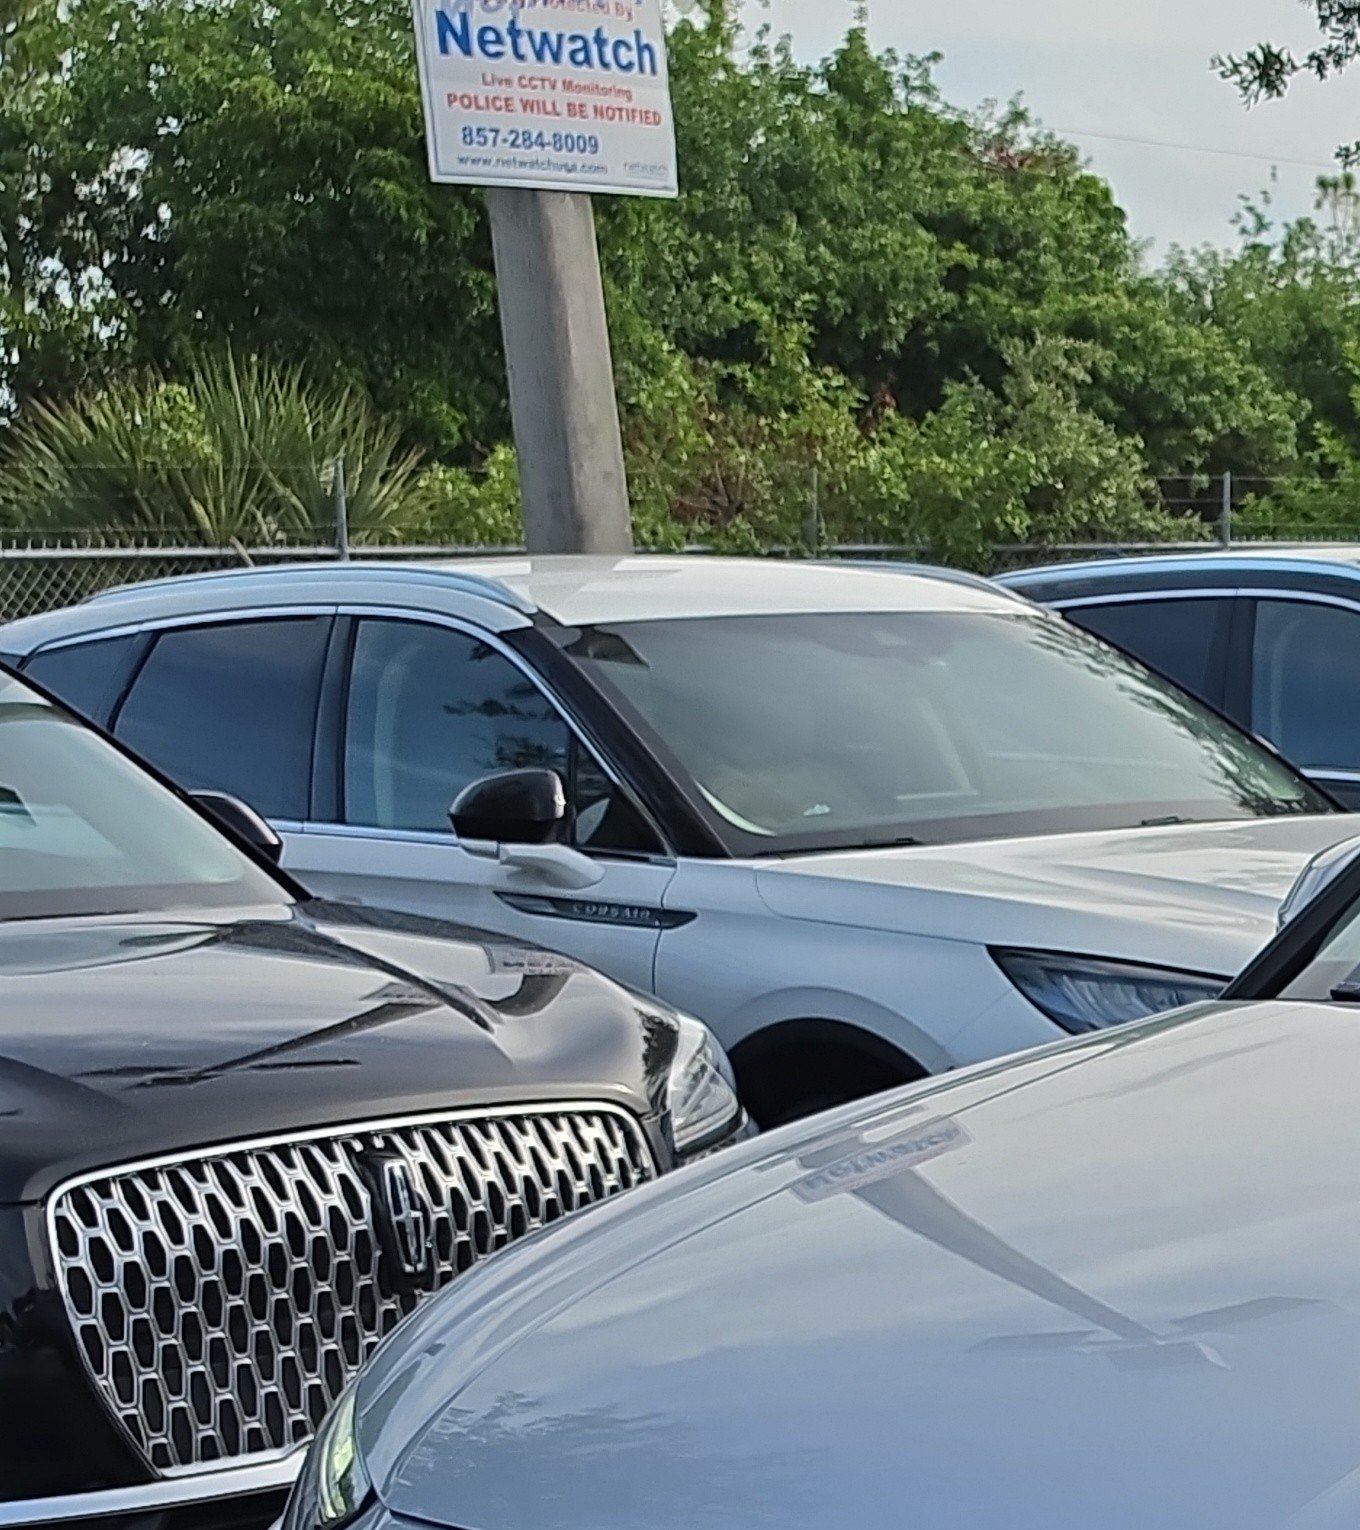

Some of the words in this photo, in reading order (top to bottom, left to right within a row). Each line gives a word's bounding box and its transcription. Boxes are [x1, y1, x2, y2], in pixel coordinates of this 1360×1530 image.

[435, 10, 658, 76] Netwatch
[482, 73, 512, 88] Live
[517, 75, 559, 92] CCTV
[562, 79, 633, 101] Monitoring
[447, 92, 515, 113] POLICE
[520, 98, 562, 117] WILL
[566, 102, 589, 119] BE
[593, 105, 662, 126] NOTIFIED
[461, 126, 600, 155] 857-284-8009
